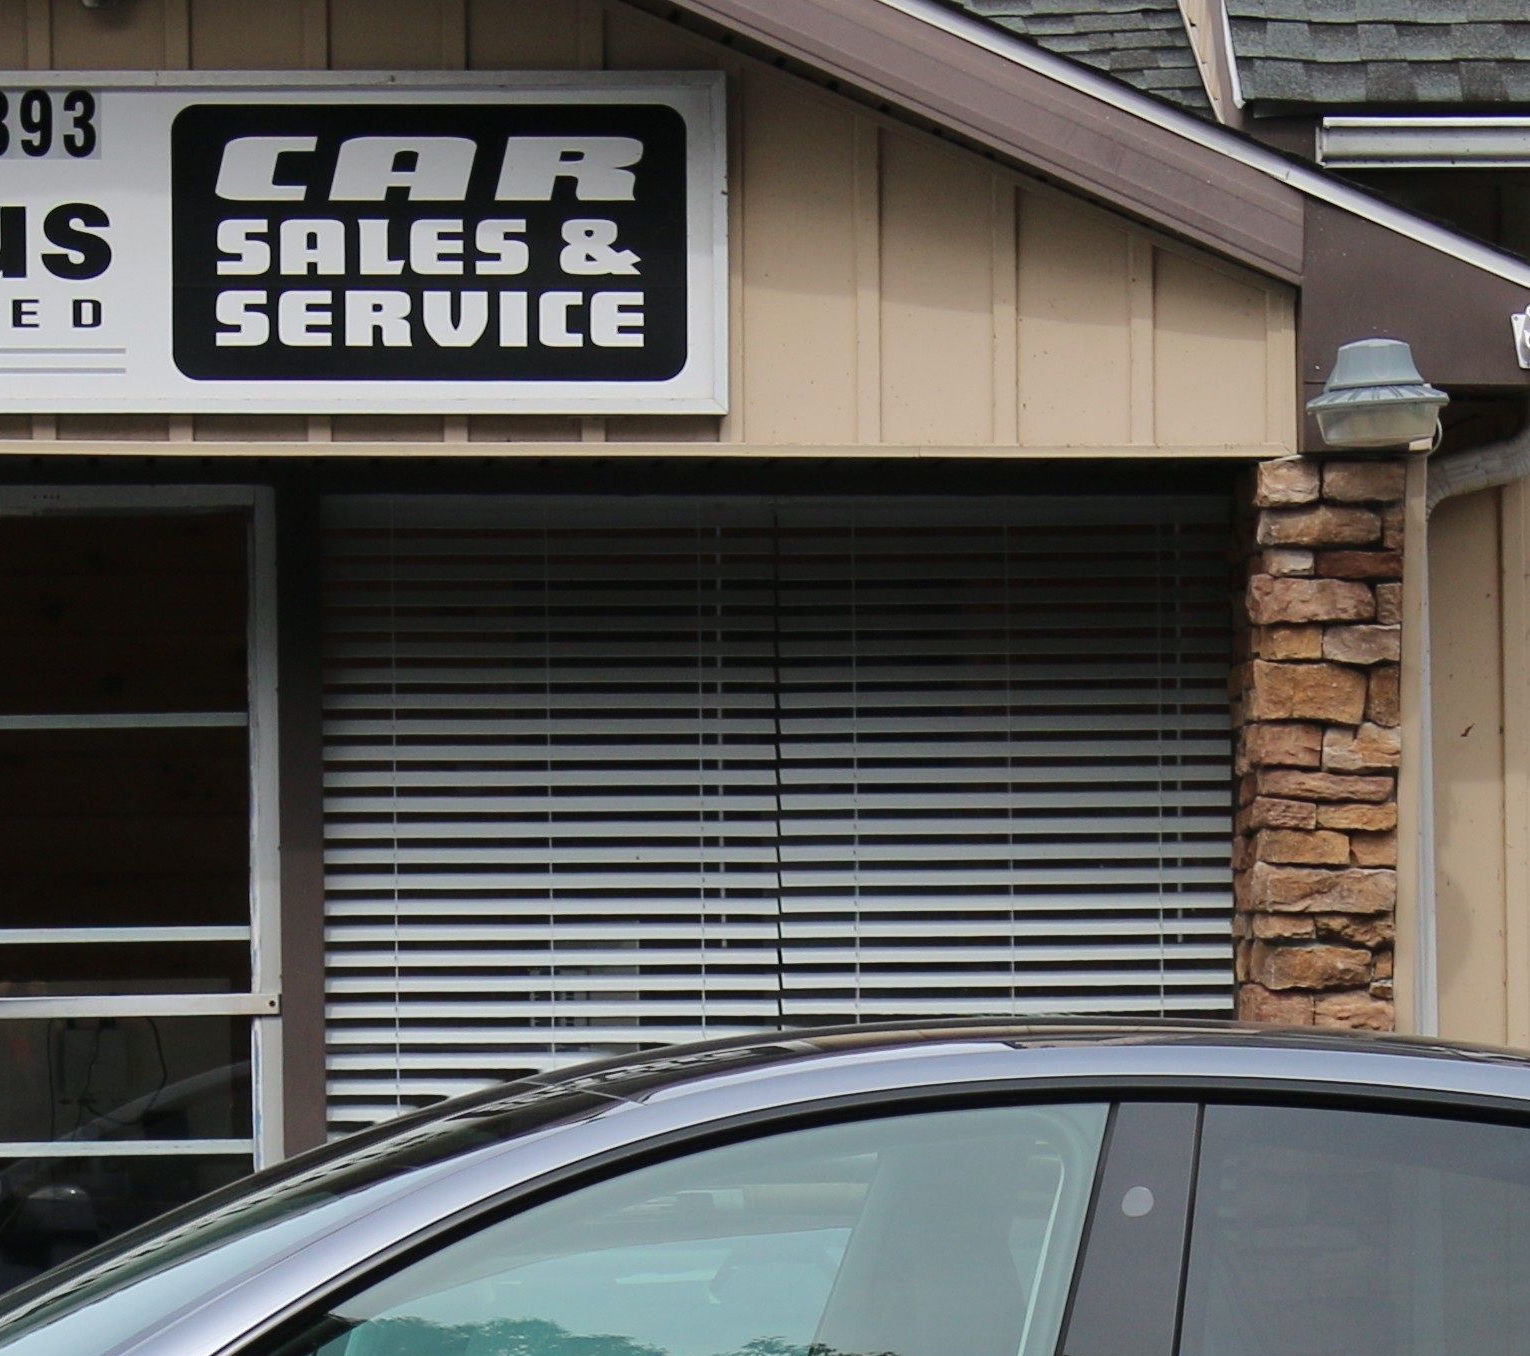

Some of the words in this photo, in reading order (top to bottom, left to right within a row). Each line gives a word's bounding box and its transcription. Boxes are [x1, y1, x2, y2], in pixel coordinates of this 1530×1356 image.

[214, 136, 644, 201] CAR
[216, 219, 530, 275] SALES
[559, 219, 642, 275] &
[215, 290, 645, 348] SERVICE
